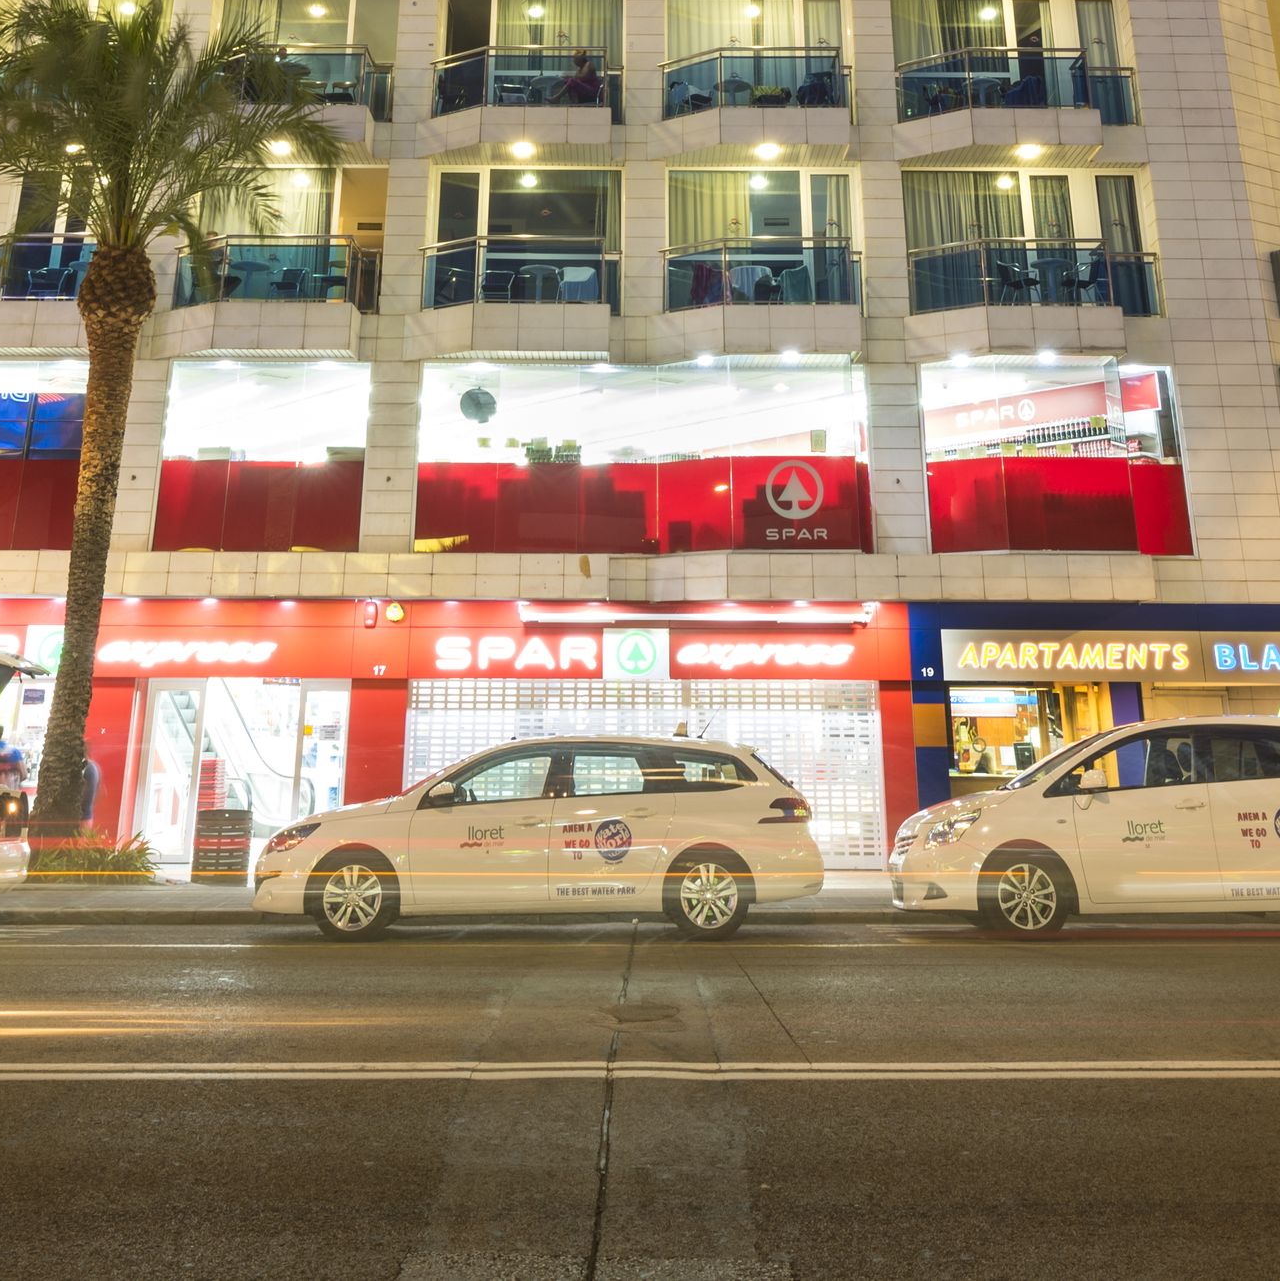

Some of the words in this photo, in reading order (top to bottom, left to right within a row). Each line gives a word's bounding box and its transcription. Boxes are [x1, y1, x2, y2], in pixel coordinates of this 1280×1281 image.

[954, 404, 1015, 429] SPAR
[765, 528, 828, 542] SPAR
[96, 639, 278, 666] express
[434, 635, 598, 671] SPAR
[676, 640, 855, 670] express
[958, 641, 1191, 671] APARTAMENTS
[373, 664, 387, 676] 17
[920, 666, 934, 679] 19
[1237, 812, 1261, 822] ANEM
[1261, 812, 1268, 822] A
[467, 825, 505, 842] lloret
[562, 823, 584, 834] ANEM
[585, 823, 593, 833] A
[1127, 819, 1166, 836] lloret
[1240, 828, 1254, 838] WE
[1255, 828, 1267, 837] GO
[564, 839, 578, 849] WE
[578, 839, 591, 849] GO
[1250, 839, 1261, 849] TO
[572, 851, 583, 861] TO
[556, 887, 570, 897] THE
[572, 887, 589, 896] BEST
[591, 886, 615, 896] WATER
[617, 886, 637, 896] PARK
[1231, 888, 1244, 897] THE
[1246, 887, 1264, 897] BEST
